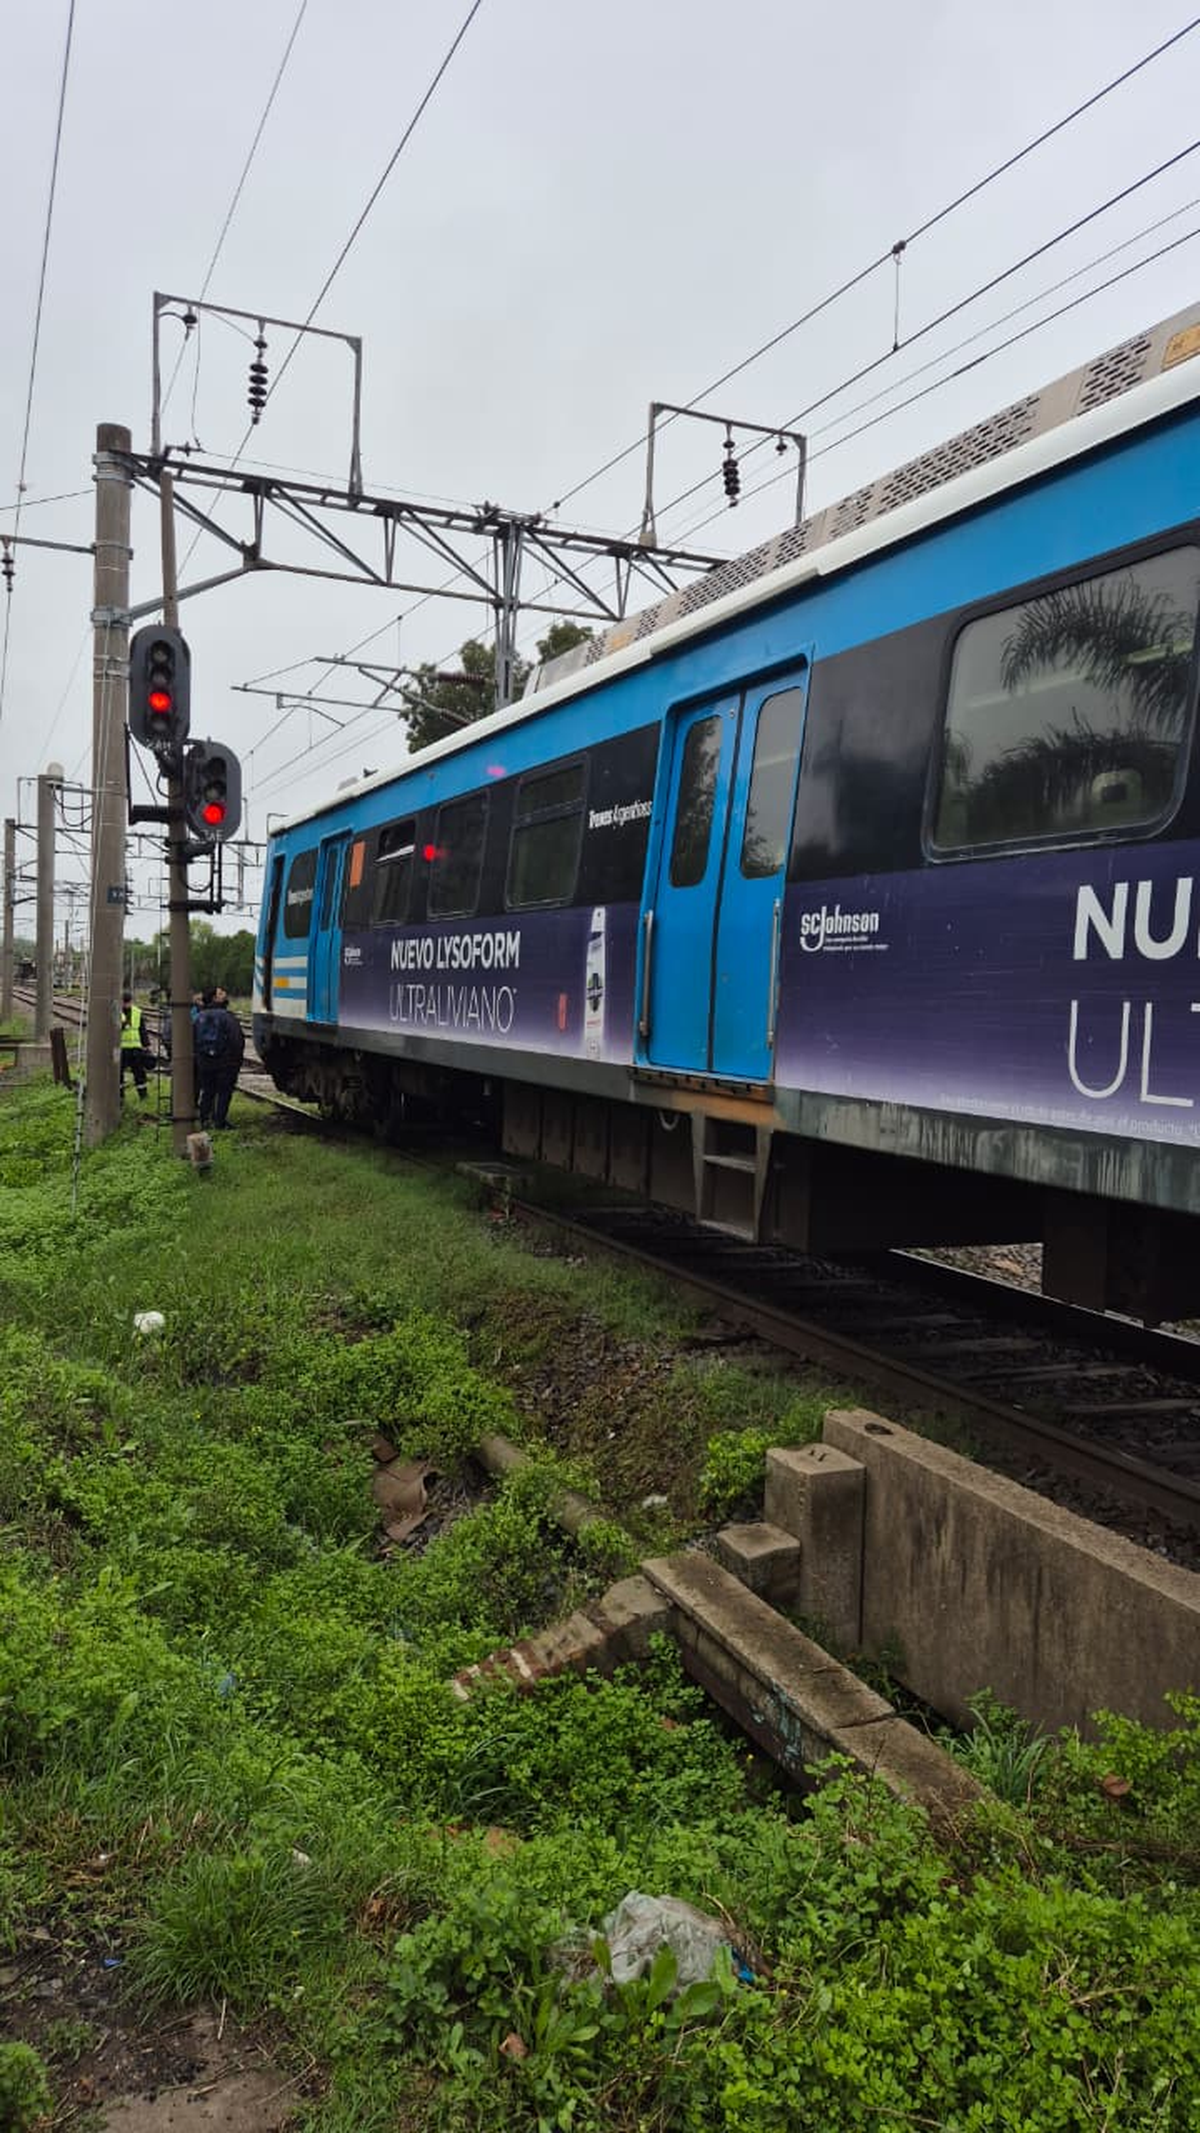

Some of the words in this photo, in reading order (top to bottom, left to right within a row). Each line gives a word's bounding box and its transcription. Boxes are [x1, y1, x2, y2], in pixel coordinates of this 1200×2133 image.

[391, 936, 434, 970] NUEVO
[436, 930, 521, 969] LYSOFORM
[1073, 877, 1200, 960] NU
[1068, 998, 1200, 1107] UL
